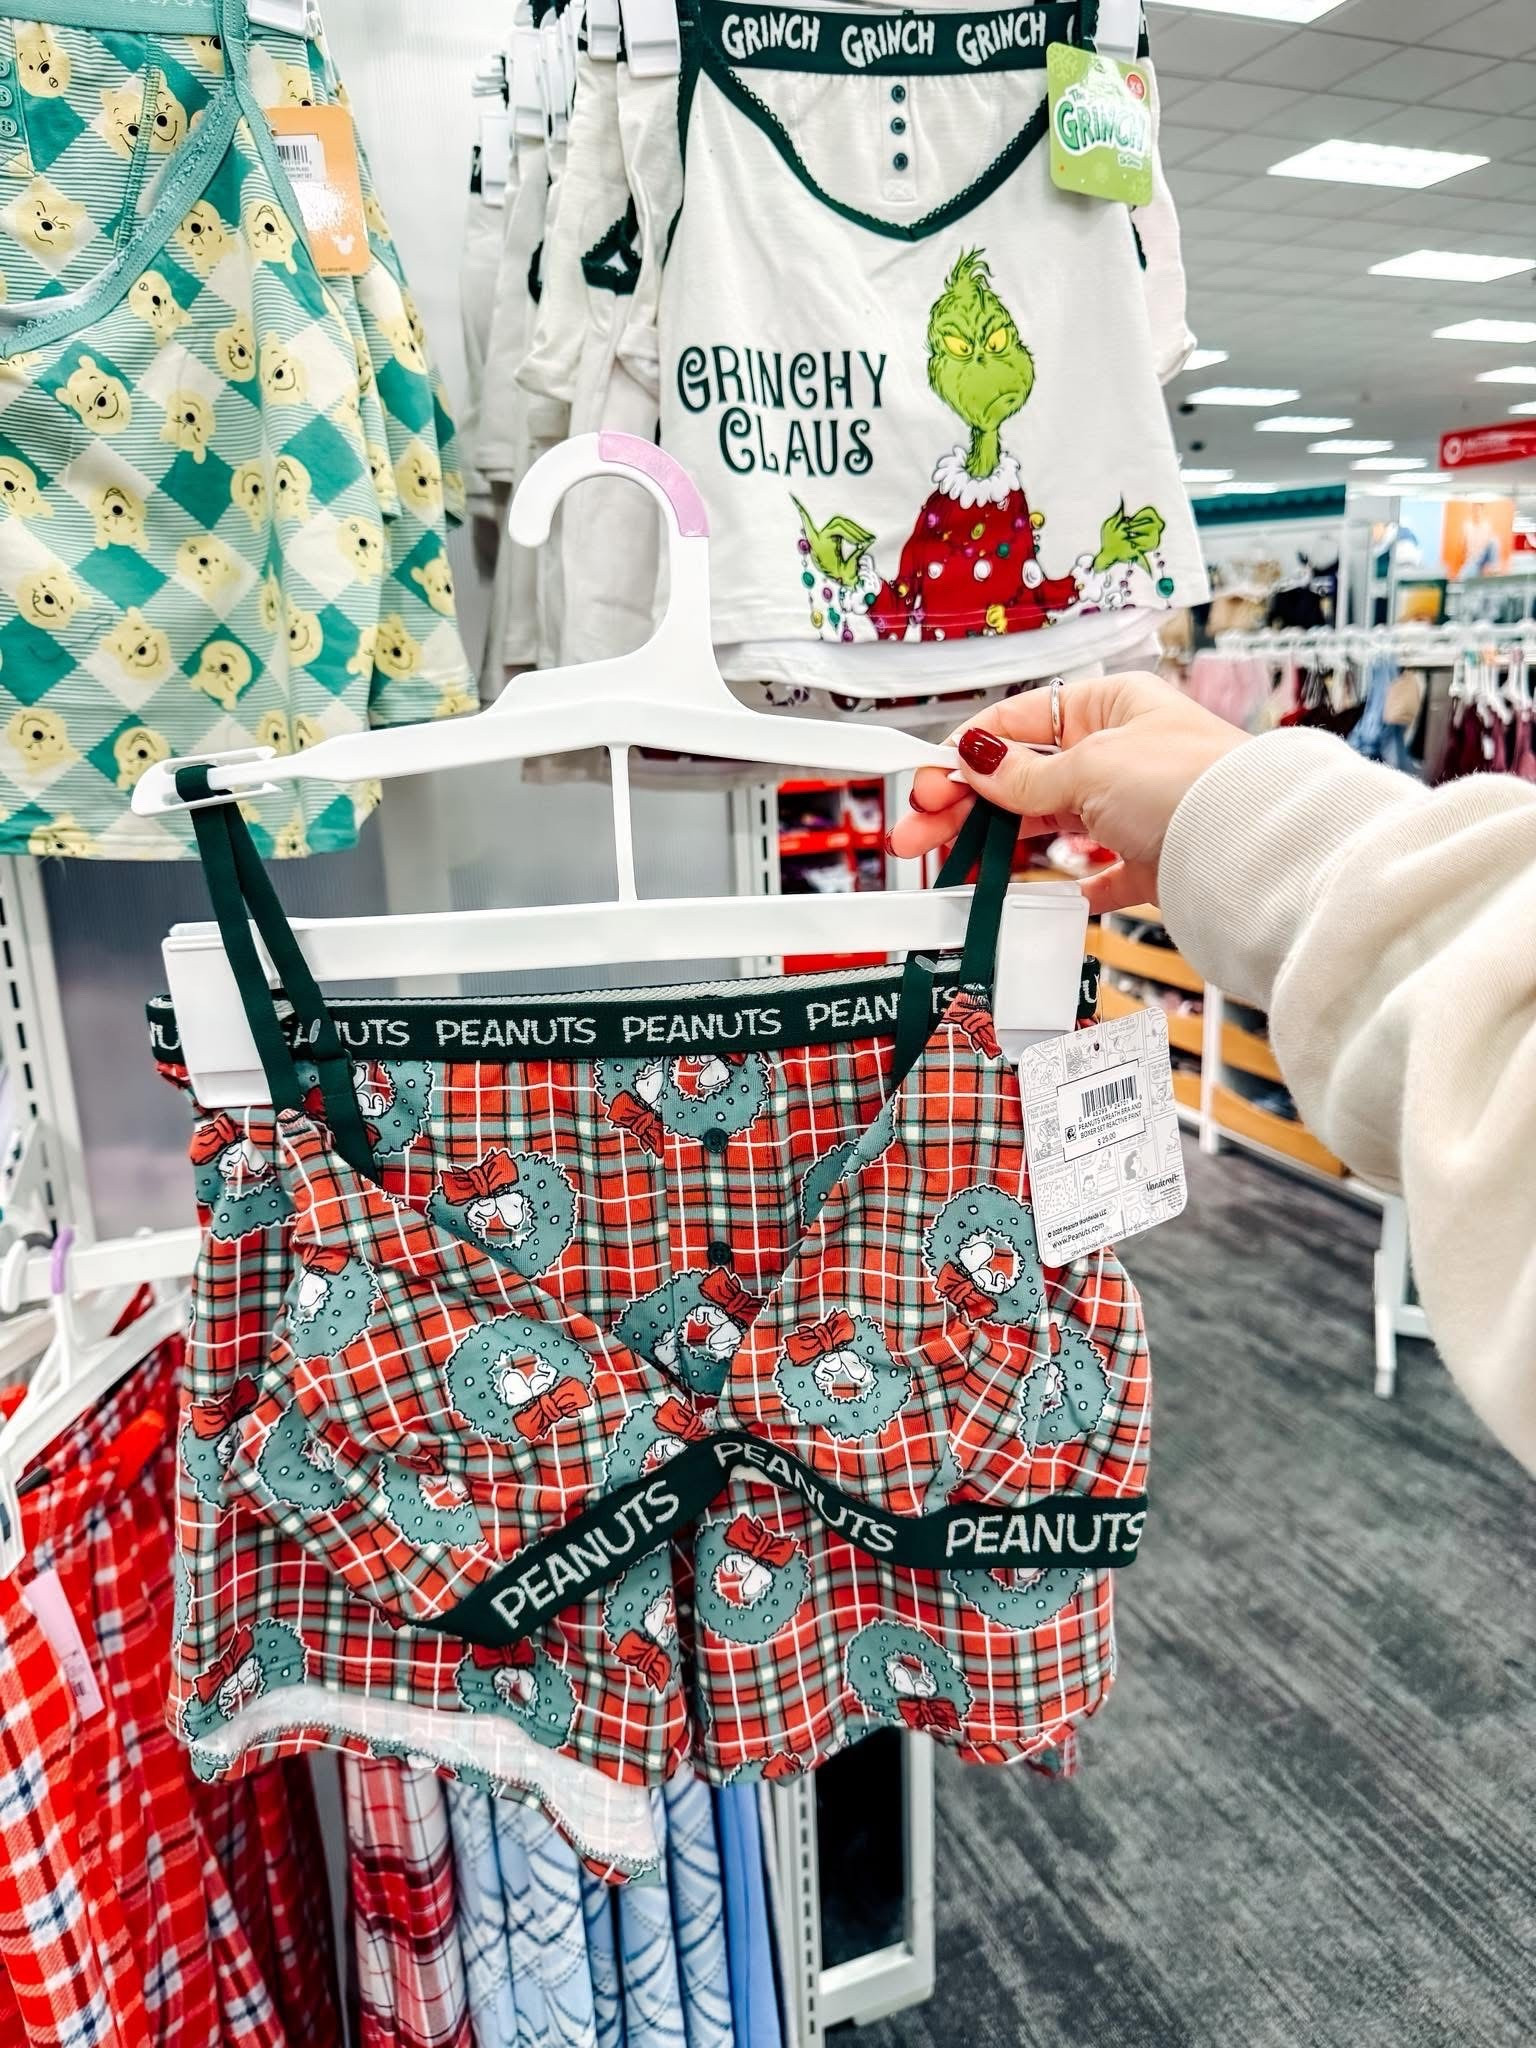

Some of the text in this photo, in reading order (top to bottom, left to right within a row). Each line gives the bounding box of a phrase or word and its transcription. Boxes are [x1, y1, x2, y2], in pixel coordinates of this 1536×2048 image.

[721, 12, 820, 60] GRINCH
[841, 19, 935, 68] GRINCH
[956, 10, 1046, 66] GRINCH
[1057, 100, 1146, 151] GRINCH
[677, 345, 887, 413] GRINCHY
[719, 407, 873, 476] CLAUS
[436, 1016, 597, 1048] PEANUTS
[622, 1008, 782, 1044] PEANUTS
[1078, 1101, 1142, 1130] PEANUTS WREATH BRA AND
[1080, 1109, 1142, 1139] BOXER SET REACTIVE PRINT
[1052, 1222, 1105, 1249] www.Peanuts.com
[713, 1442, 897, 1553] PEANUTS
[489, 1480, 682, 1630] PEANUTS
[946, 1509, 1147, 1558] PEANUTS
